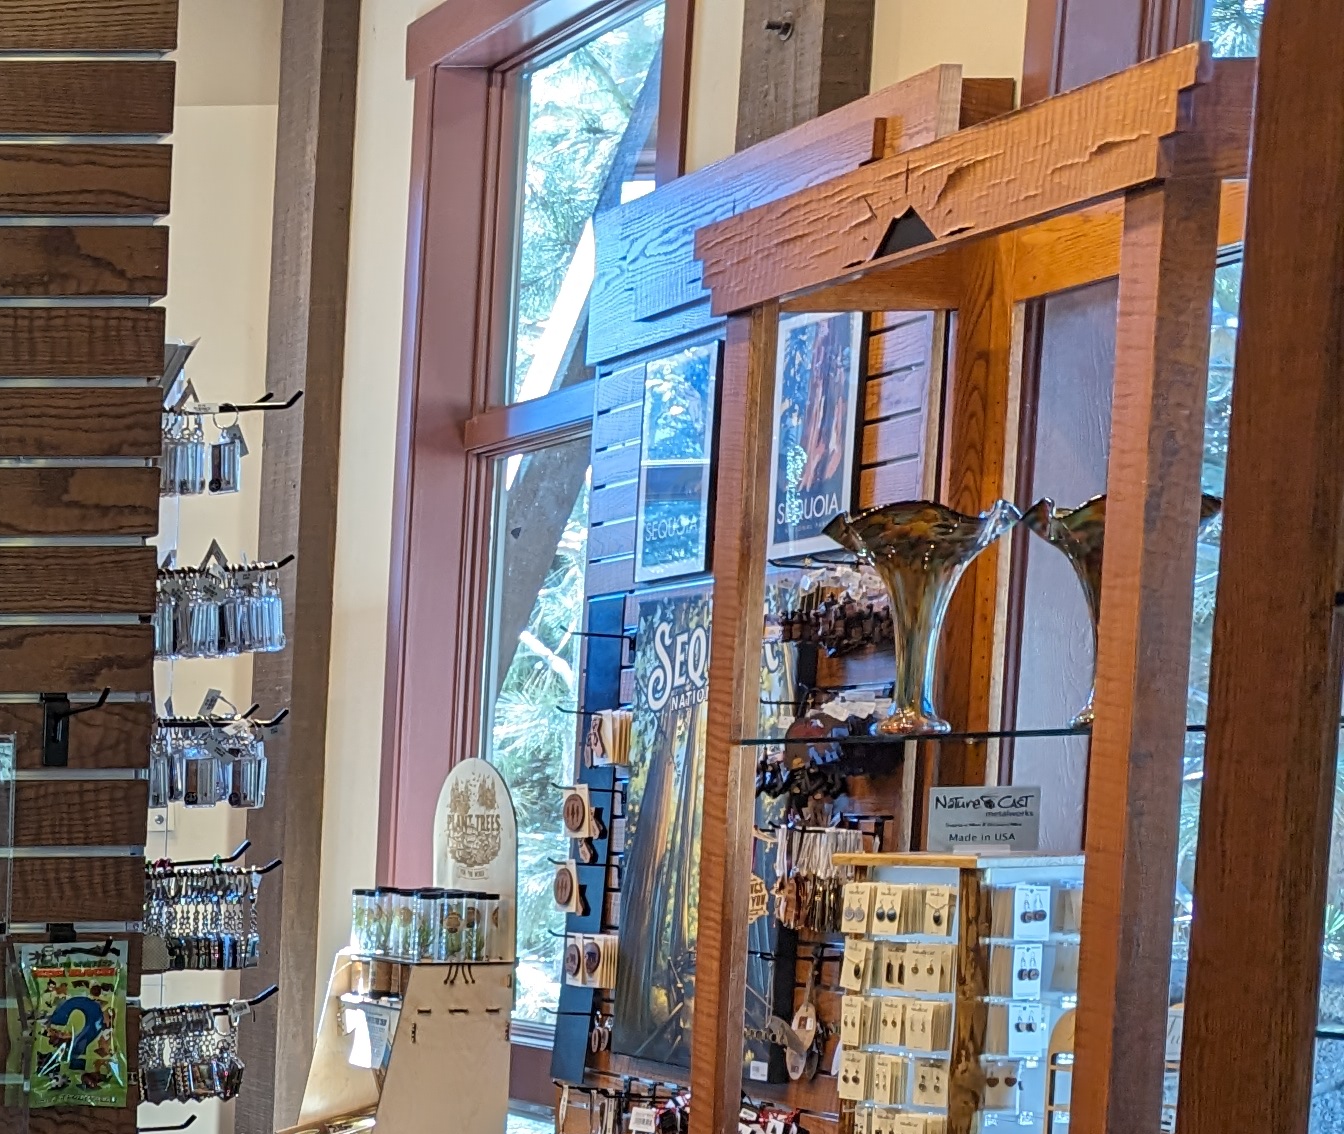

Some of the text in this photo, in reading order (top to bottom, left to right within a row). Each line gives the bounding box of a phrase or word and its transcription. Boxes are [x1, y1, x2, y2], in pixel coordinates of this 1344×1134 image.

[474, 813, 501, 832] TREES
[948, 833, 978, 842] Made
[994, 832, 1016, 841] USA
